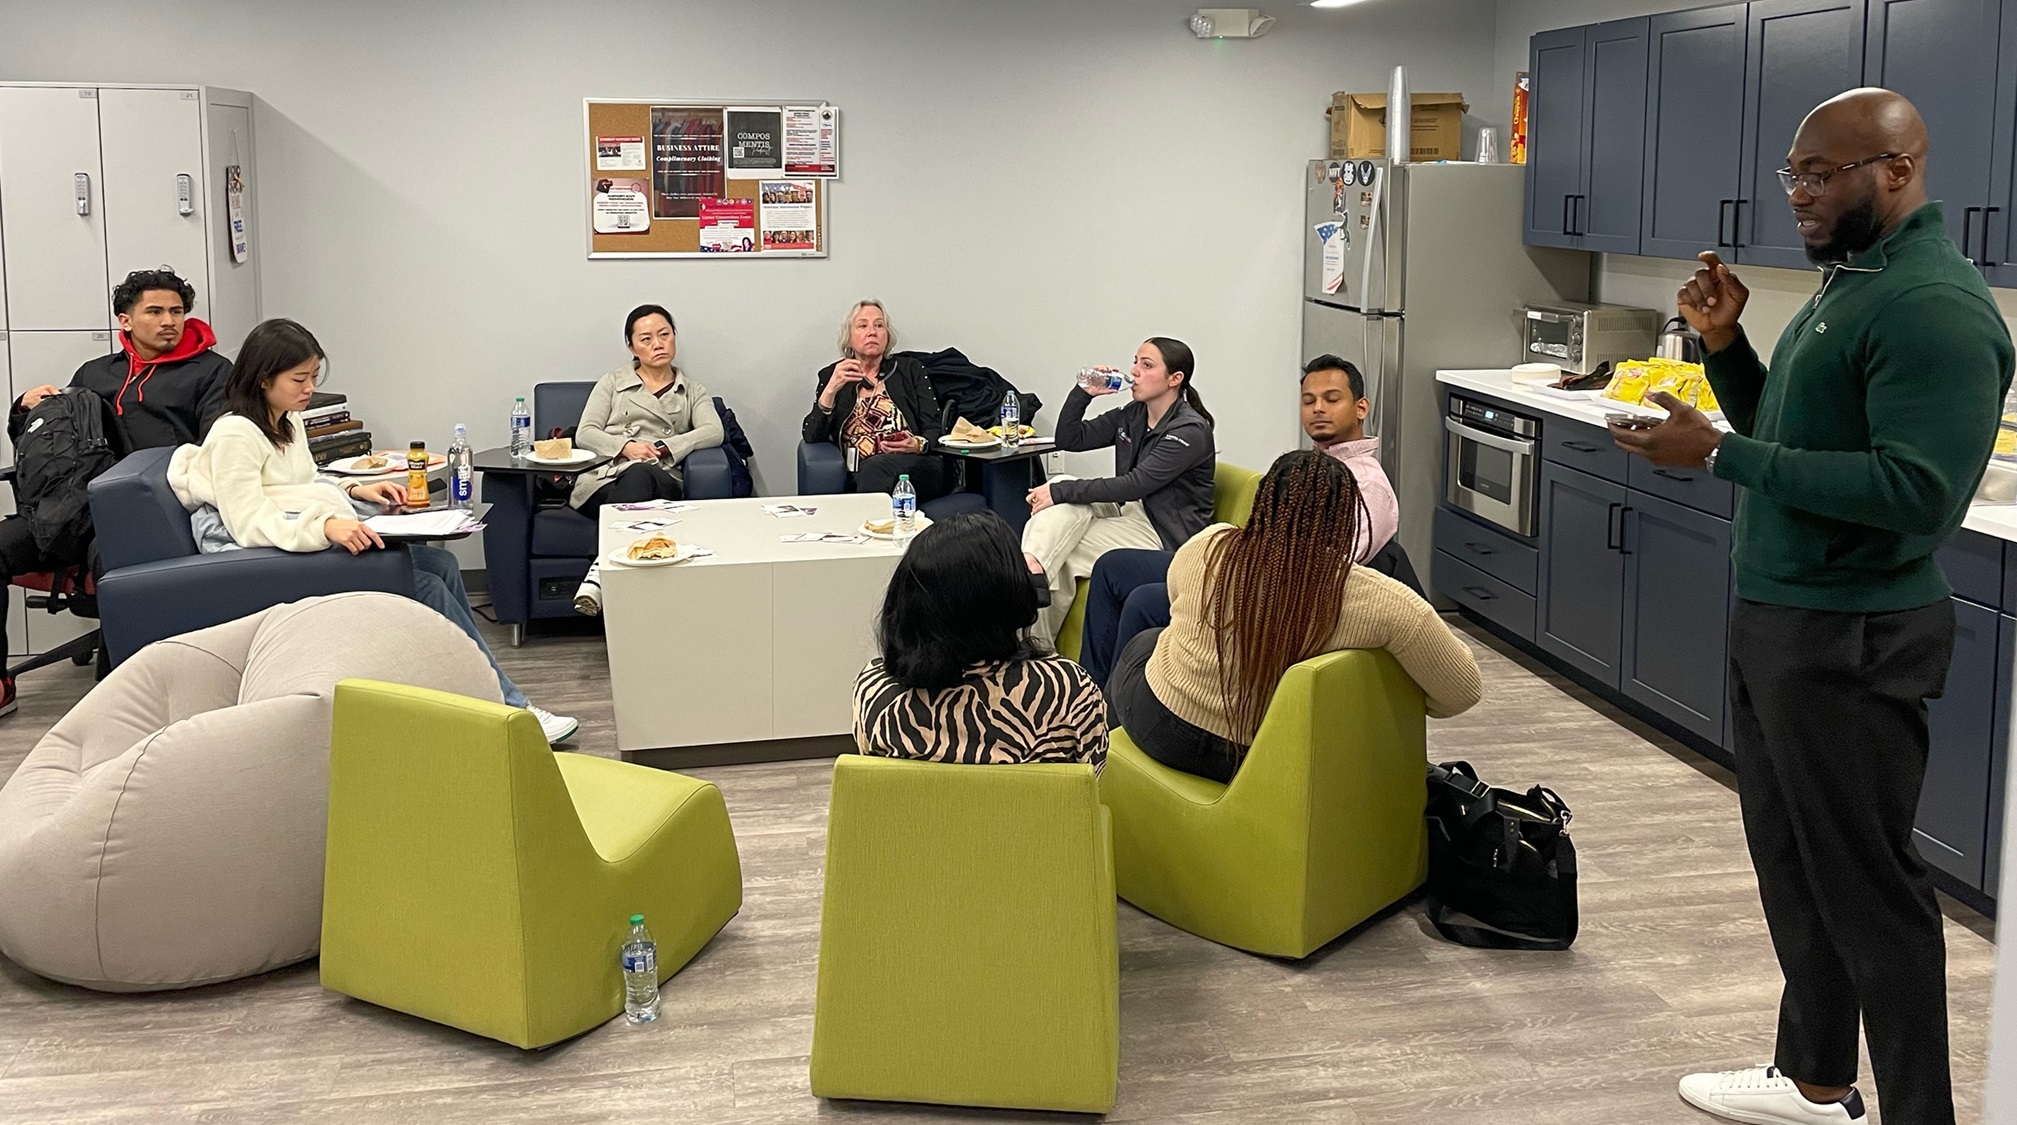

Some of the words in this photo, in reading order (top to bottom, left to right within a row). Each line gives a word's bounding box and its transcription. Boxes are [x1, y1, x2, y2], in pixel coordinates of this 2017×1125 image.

[737, 132, 771, 140] COMPOS
[697, 155, 722, 163] Clothing
[458, 464, 468, 496] smart
